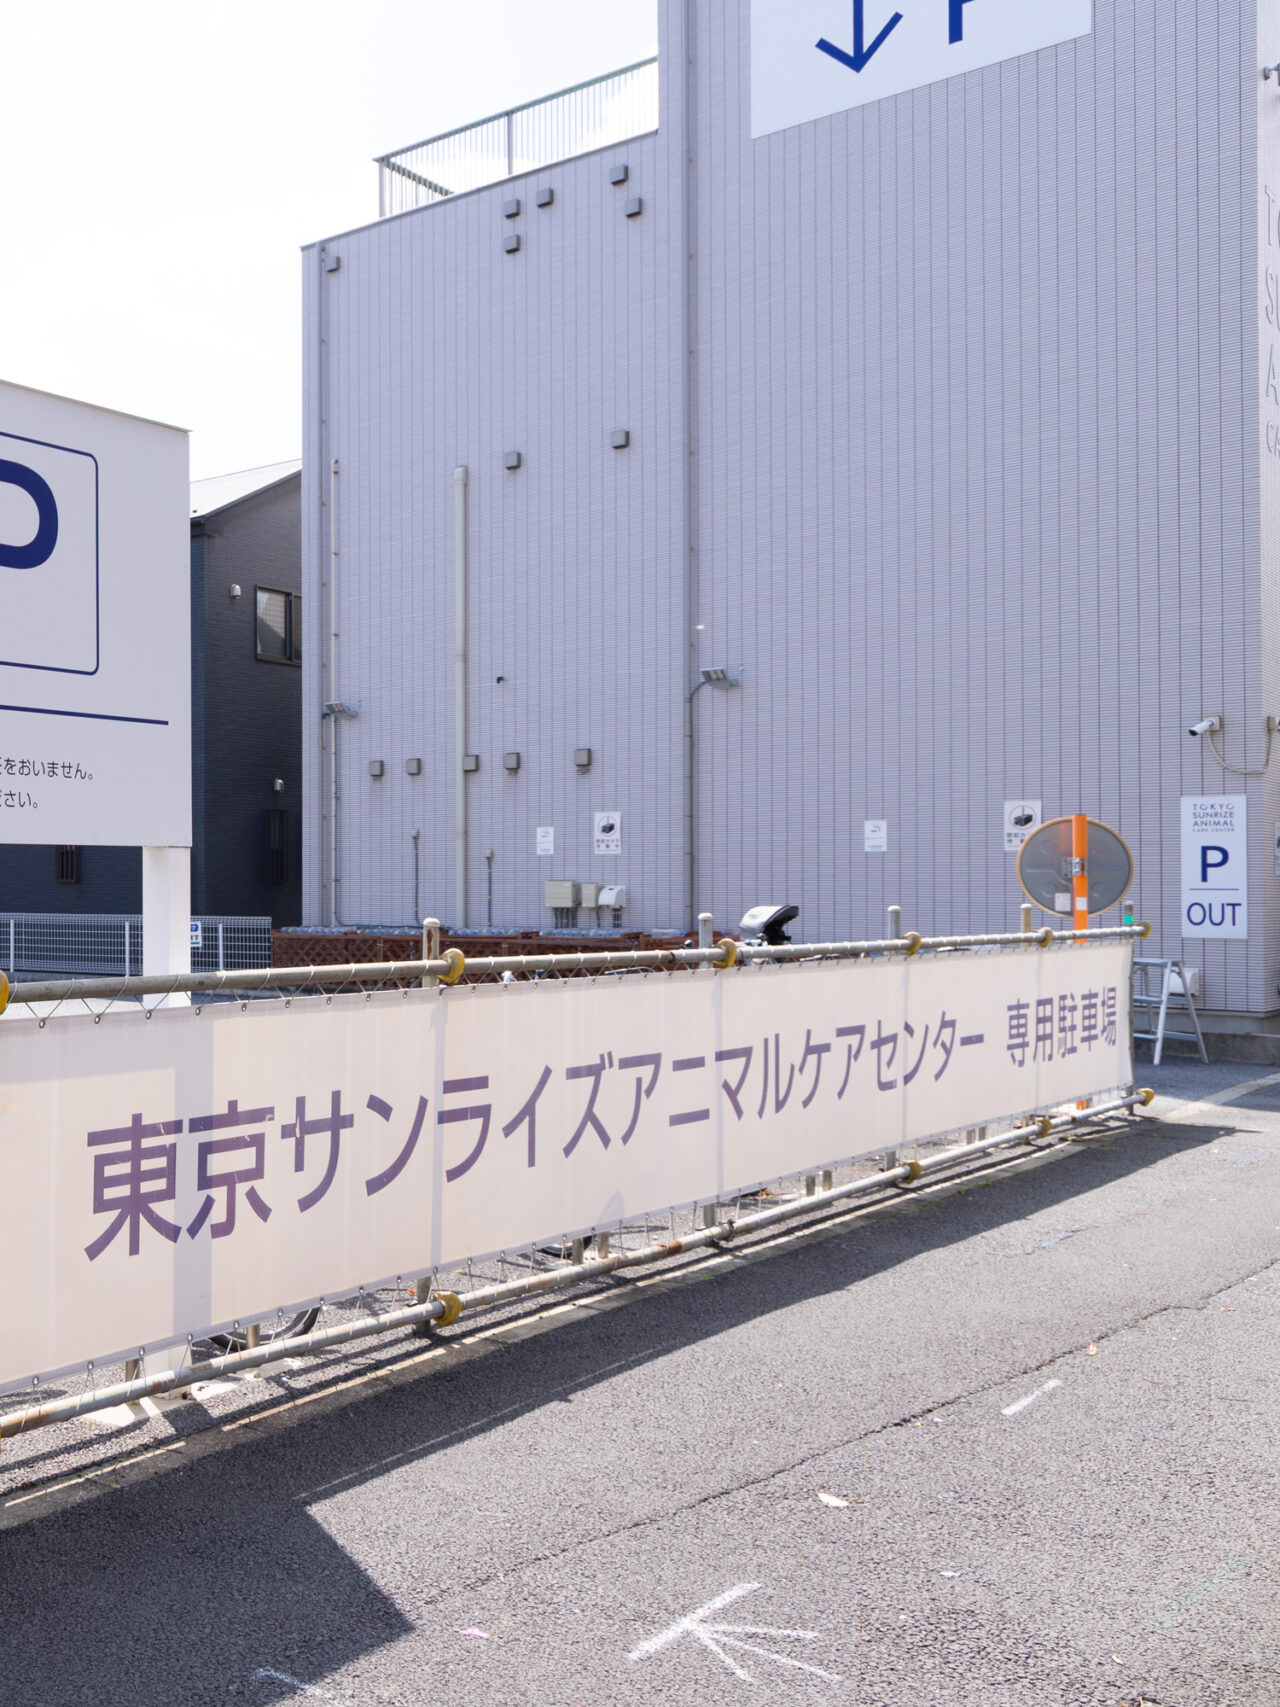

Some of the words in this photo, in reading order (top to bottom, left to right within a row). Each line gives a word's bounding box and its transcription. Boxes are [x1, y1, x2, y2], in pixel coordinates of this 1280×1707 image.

[1192, 811, 1234, 819] SUNRIZE
[1201, 846, 1229, 883] P
[1187, 902, 1242, 926] OUT
[85, 1012, 984, 1261] 東京サンライズアニマルケアセンター
[1006, 987, 1117, 1068] 専用駐車場
